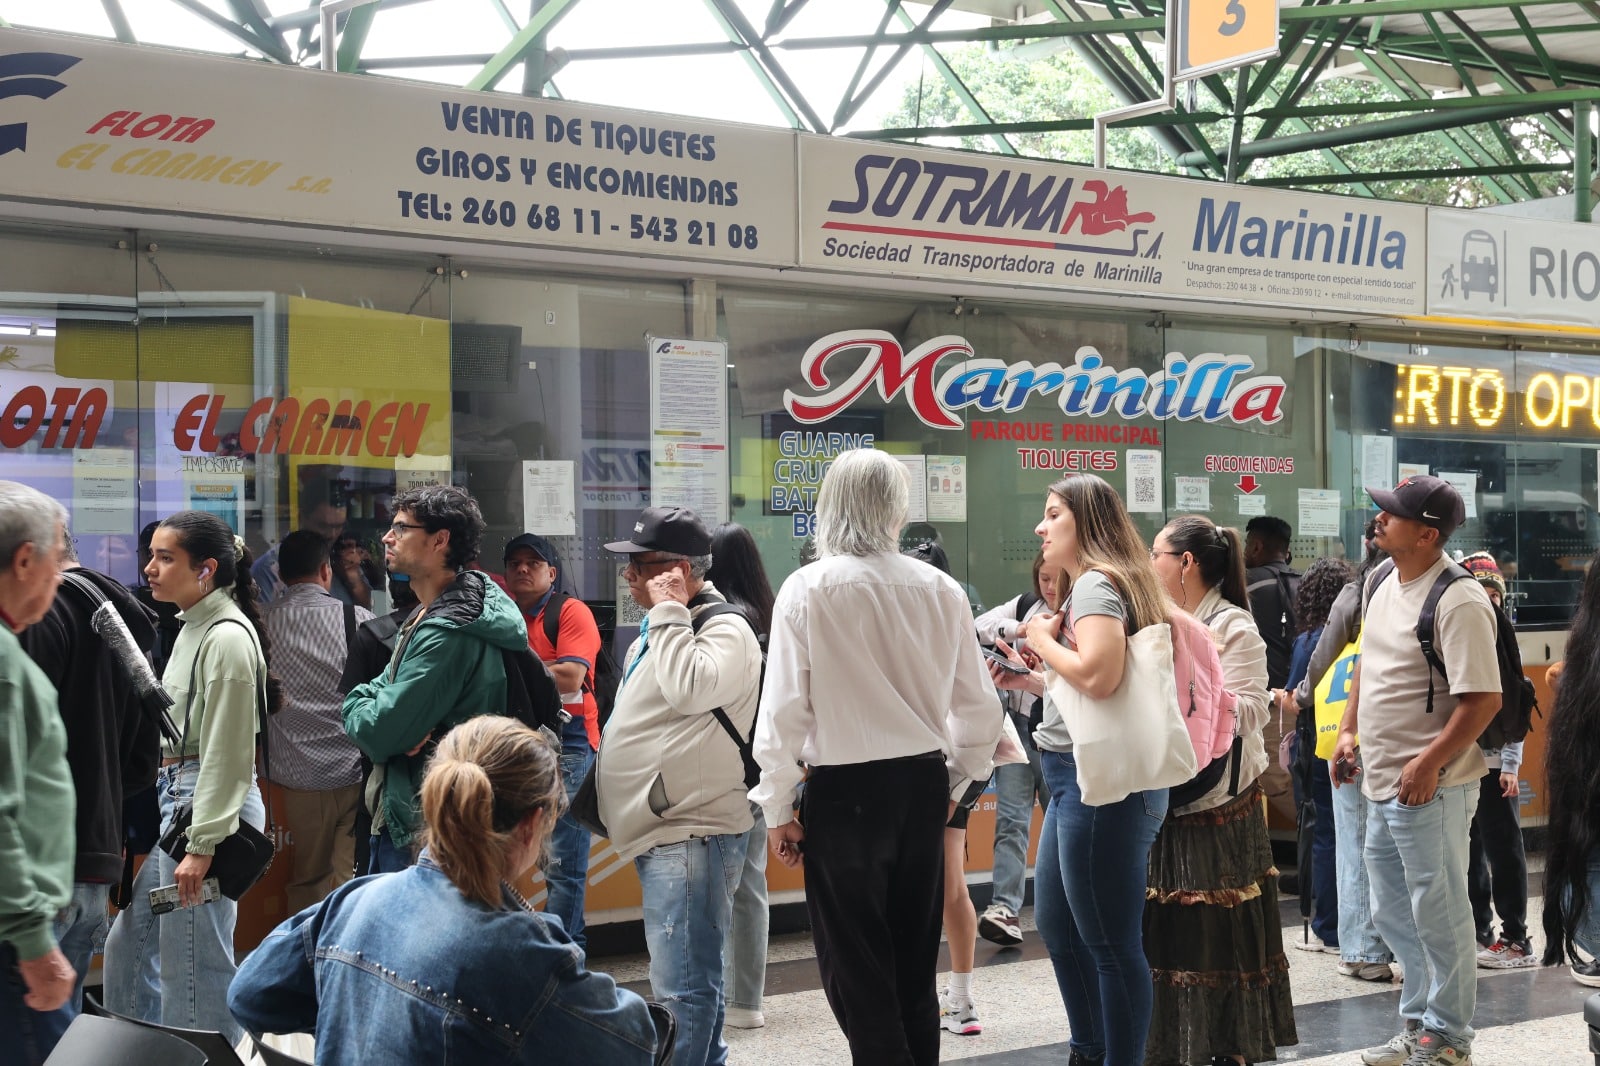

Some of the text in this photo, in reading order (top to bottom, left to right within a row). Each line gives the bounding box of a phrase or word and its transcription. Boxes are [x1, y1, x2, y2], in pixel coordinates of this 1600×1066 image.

[86, 111, 215, 143] FLOTA
[441, 102, 716, 162] VENTA DE TIQUETES
[56, 143, 109, 171] EL
[111, 148, 283, 186] CARMEN
[416, 147, 738, 206] GIROS Y ENCOMIENDAS
[398, 191, 451, 221] TEL:
[462, 197, 516, 227] 260
[527, 204, 561, 231] 68
[573, 208, 600, 235] 11
[630, 215, 678, 243] 543
[687, 221, 716, 247] 21
[728, 224, 758, 250] 08
[1192, 198, 1407, 270] Marinilla
[823, 237, 1162, 284] Sociedad Transportadora de Marinilla
[1206, 265, 1226, 275] gran
[1227, 266, 1261, 277] empresa
[1263, 268, 1274, 278] de
[1275, 270, 1316, 282] transporte
[1317, 274, 1331, 282] con
[1333, 275, 1363, 286] especial
[1364, 278, 1392, 289] sentido
[1529, 246, 1600, 302] RIO
[784, 329, 1285, 430] Marinilla
[173, 394, 431, 458] EL CARMEN
[971, 421, 1161, 446] PARQUE PRINCIPAL
[1017, 447, 1118, 471] TIQUETES
[1204, 455, 1295, 475] ENCOMIENDAS
